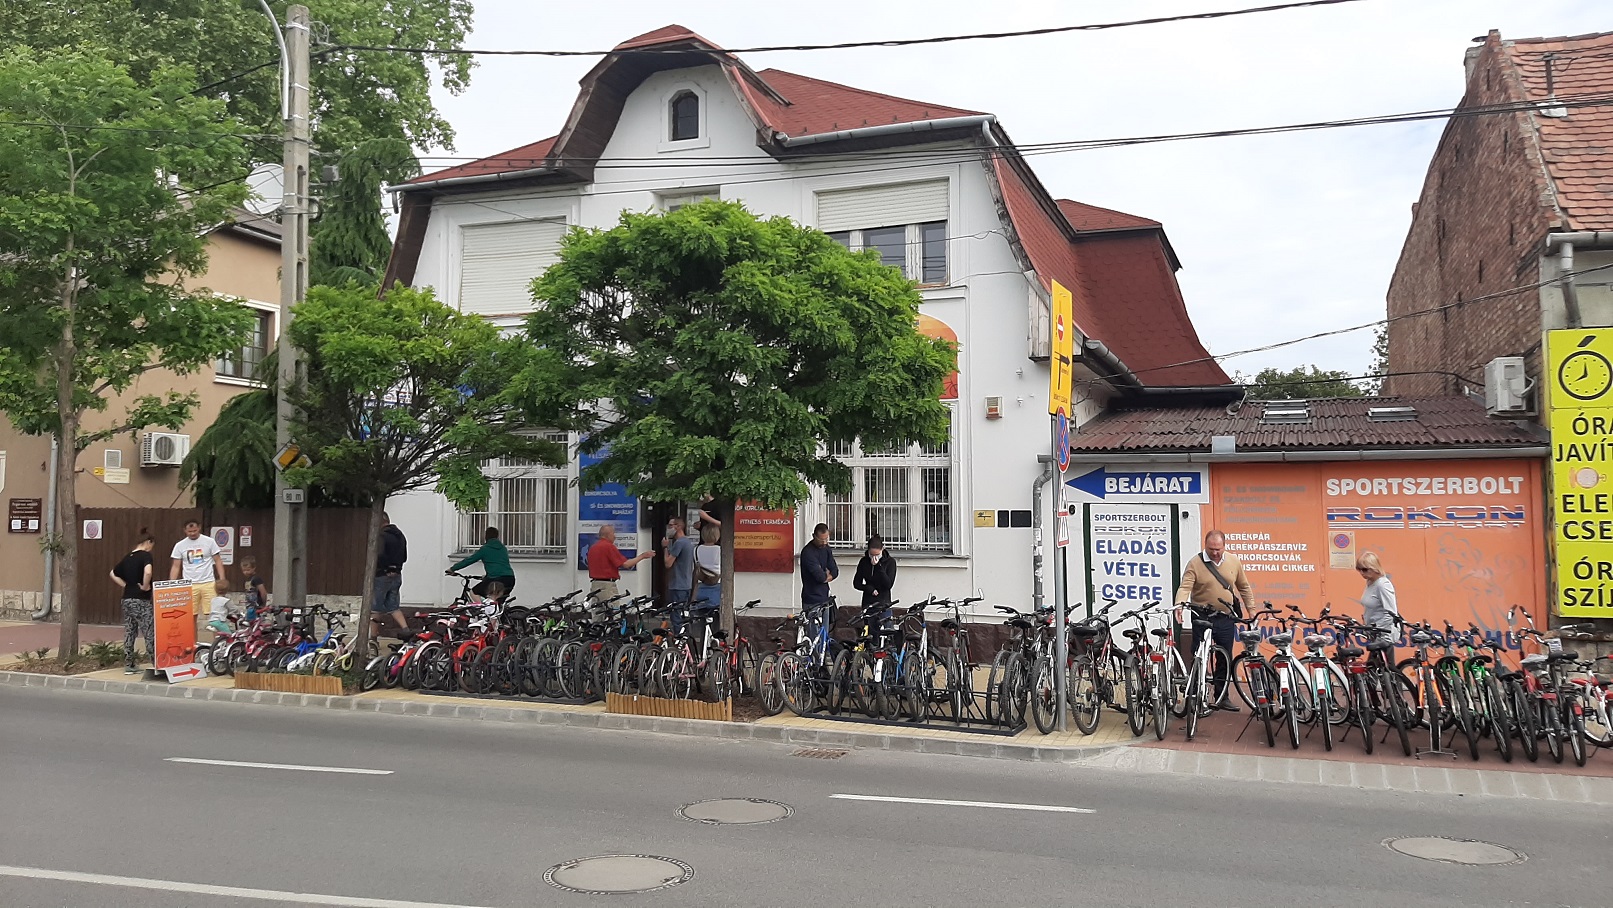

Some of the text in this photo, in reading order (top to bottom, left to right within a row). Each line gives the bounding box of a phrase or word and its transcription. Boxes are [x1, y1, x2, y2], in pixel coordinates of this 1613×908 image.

[1572, 412, 1613, 435] ÓR
[1105, 473, 1192, 493] BEJÁRAT
[1326, 477, 1524, 496] SPORTSZERBOLT
[1327, 505, 1525, 520] ROKON
[1562, 494, 1613, 513] ELE
[1094, 514, 1166, 522] SPORTSZERBOLT
[1225, 532, 1270, 540] KERÉKPÁR
[1096, 536, 1167, 555] ELADÁS
[1233, 552, 1301, 562] RKORCSOLYÁK
[1103, 559, 1161, 577] VÉTEL
[1102, 584, 1162, 601] CSERE
